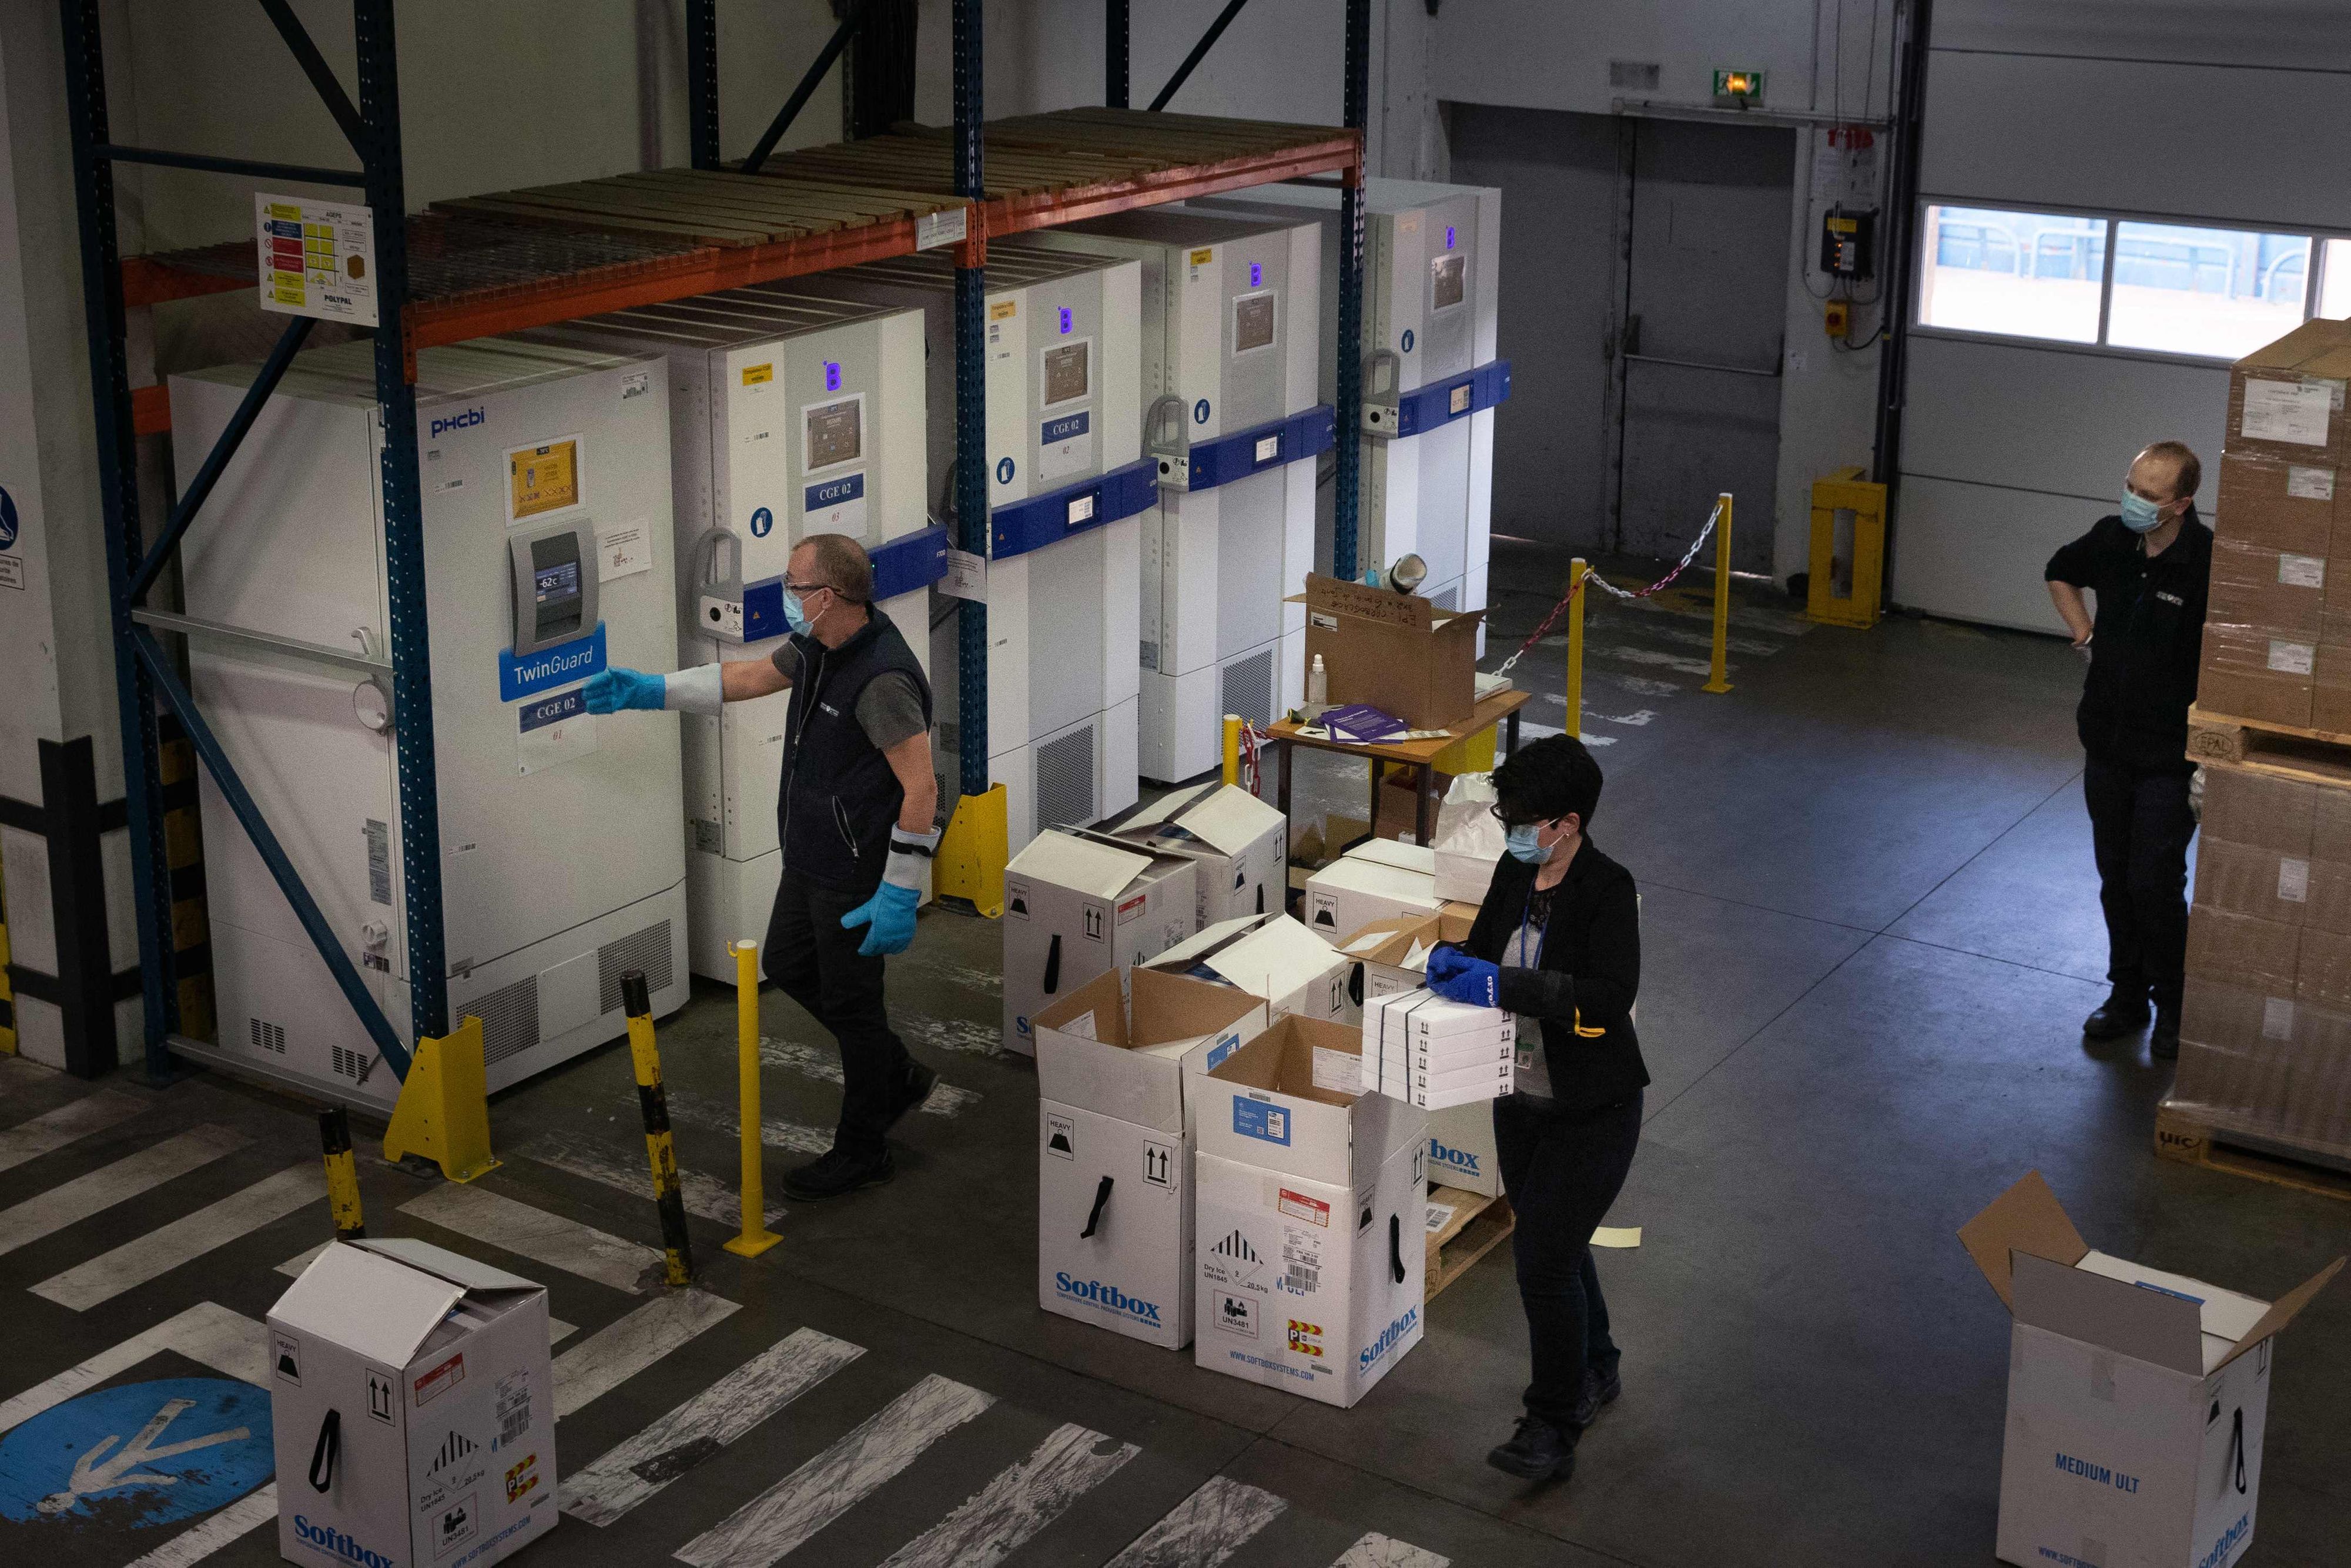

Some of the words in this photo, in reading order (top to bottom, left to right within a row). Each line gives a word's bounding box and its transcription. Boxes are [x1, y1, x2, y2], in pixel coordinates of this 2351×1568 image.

[324, 294, 352, 305] POLYPAL
[1053, 421, 1070, 435] CGE
[1071, 420, 1079, 431] 02
[819, 485, 839, 501] CGE
[842, 483, 851, 494] 02
[514, 645, 593, 685] TwinGuard
[537, 702, 562, 719] CGE
[564, 698, 575, 711] 02
[1011, 887, 1027, 896] HEAVY
[1316, 899, 1335, 907] HEAVY
[1374, 981, 1395, 990] HEAVY
[1050, 1120, 1071, 1131] HEAVY
[1205, 1264, 1215, 1274] Dry
[1205, 1272, 1227, 1284] UN1845
[1056, 1272, 1161, 1321] Softbox
[1223, 1316, 1249, 1329] UN3481
[1359, 1305, 1417, 1371] Softbox
[277, 1339, 296, 1352] HEAVY
[1230, 1350, 1314, 1381] WWW.SOFTBOXSYSTEMS.COM
[2056, 1453, 2111, 1485] MEDIUM
[2116, 1473, 2139, 1494] ULT
[420, 1493, 432, 1503] Dry
[421, 1493, 446, 1512] UN1845
[443, 1526, 469, 1546] UN3481
